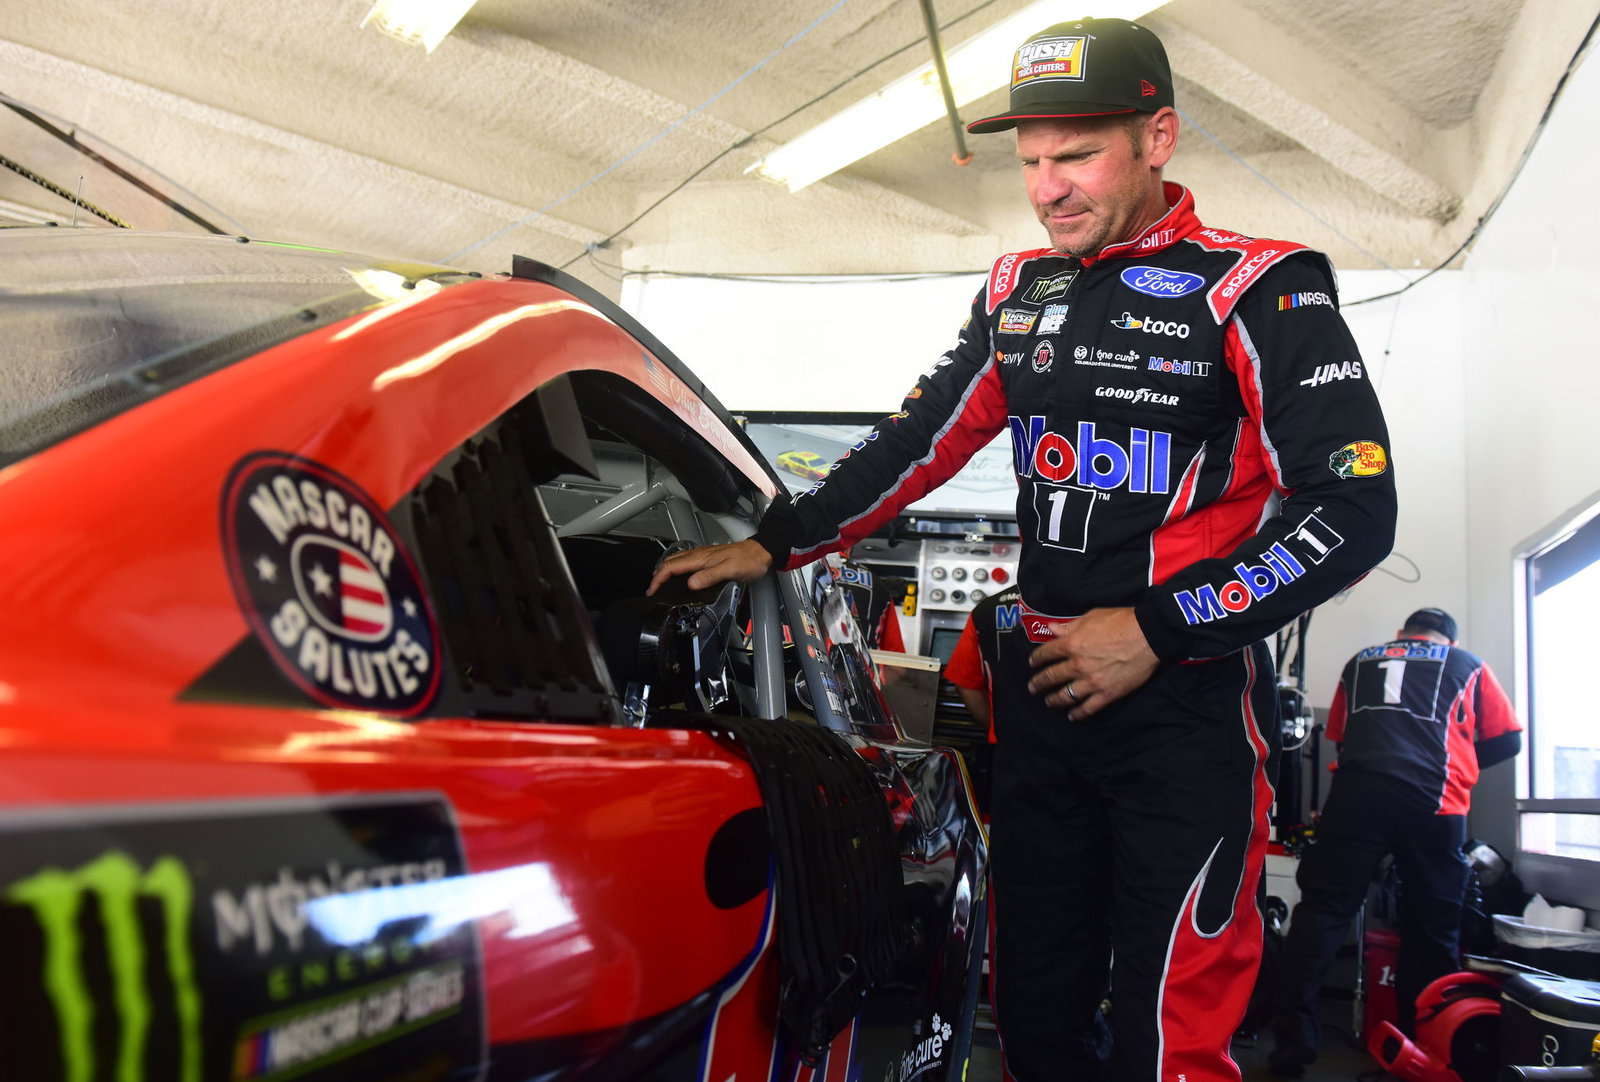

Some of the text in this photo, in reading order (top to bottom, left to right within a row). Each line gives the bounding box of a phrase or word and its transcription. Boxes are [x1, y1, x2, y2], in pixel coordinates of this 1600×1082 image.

[1017, 41, 1075, 66] RUSH
[1034, 63, 1066, 73] CENTERS
[996, 254, 1019, 293] sparco
[1134, 269, 1191, 294] Ford
[1222, 249, 1280, 299] sparco
[1143, 316, 1190, 339] toco
[1115, 353, 1134, 362] cure
[1148, 356, 1191, 375] Mobil
[1301, 361, 1362, 387] HAAS
[1095, 386, 1180, 406] GOODYEAR
[1008, 415, 1171, 495] Mobil
[1356, 442, 1378, 453] Bass
[1359, 451, 1375, 460] Pro
[249, 474, 396, 579] NASCAR
[1048, 490, 1068, 542] 1
[830, 564, 873, 589] obil
[1173, 541, 1307, 625] Mobil
[1031, 621, 1053, 636] Clin
[270, 599, 429, 699] SALUTES
[1359, 645, 1449, 661] Mobil
[1377, 660, 1407, 704] 1
[266, 934, 433, 999] ENERG
[915, 1034, 943, 1067] cure
